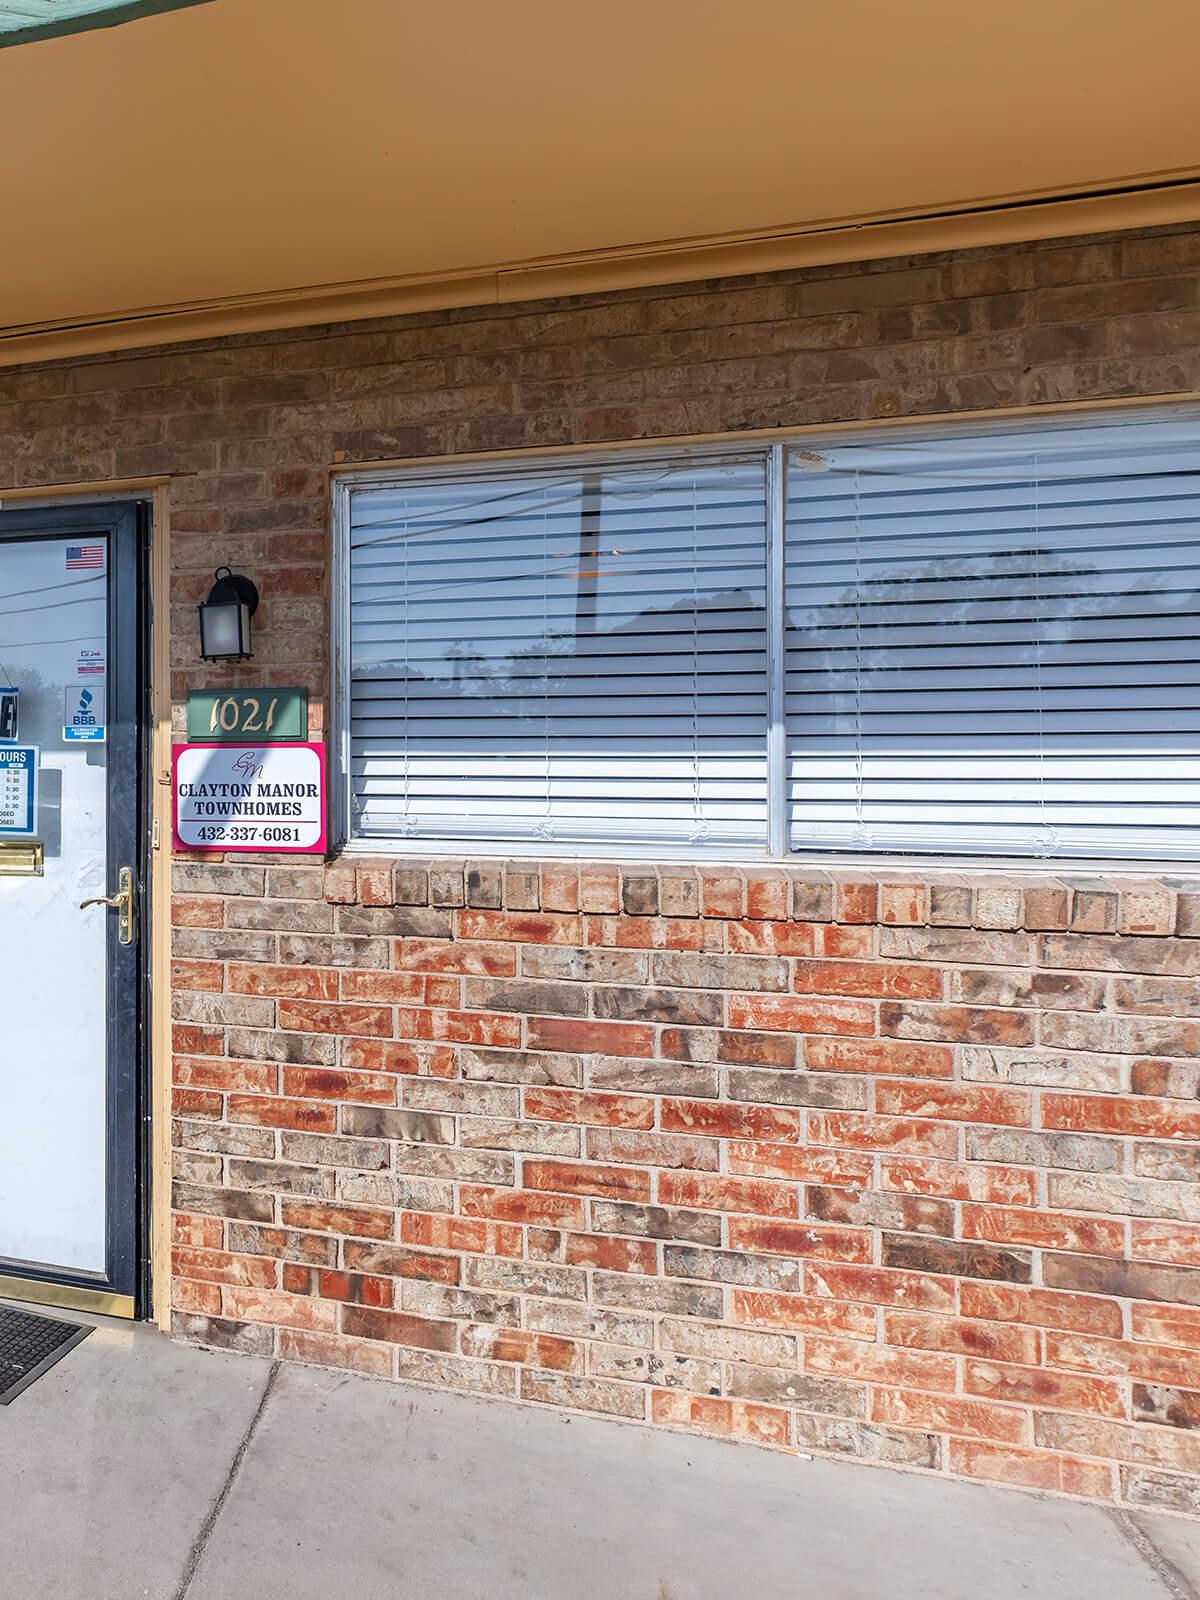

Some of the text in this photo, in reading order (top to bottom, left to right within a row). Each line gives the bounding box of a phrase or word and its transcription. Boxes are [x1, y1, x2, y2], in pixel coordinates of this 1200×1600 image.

[73, 716, 96, 725] BBB
[209, 696, 278, 732] 1021
[179, 783, 319, 798] CLAYTON MANOR
[194, 801, 302, 816] TOWNHOMES
[197, 826, 301, 842] 432-337-6081
